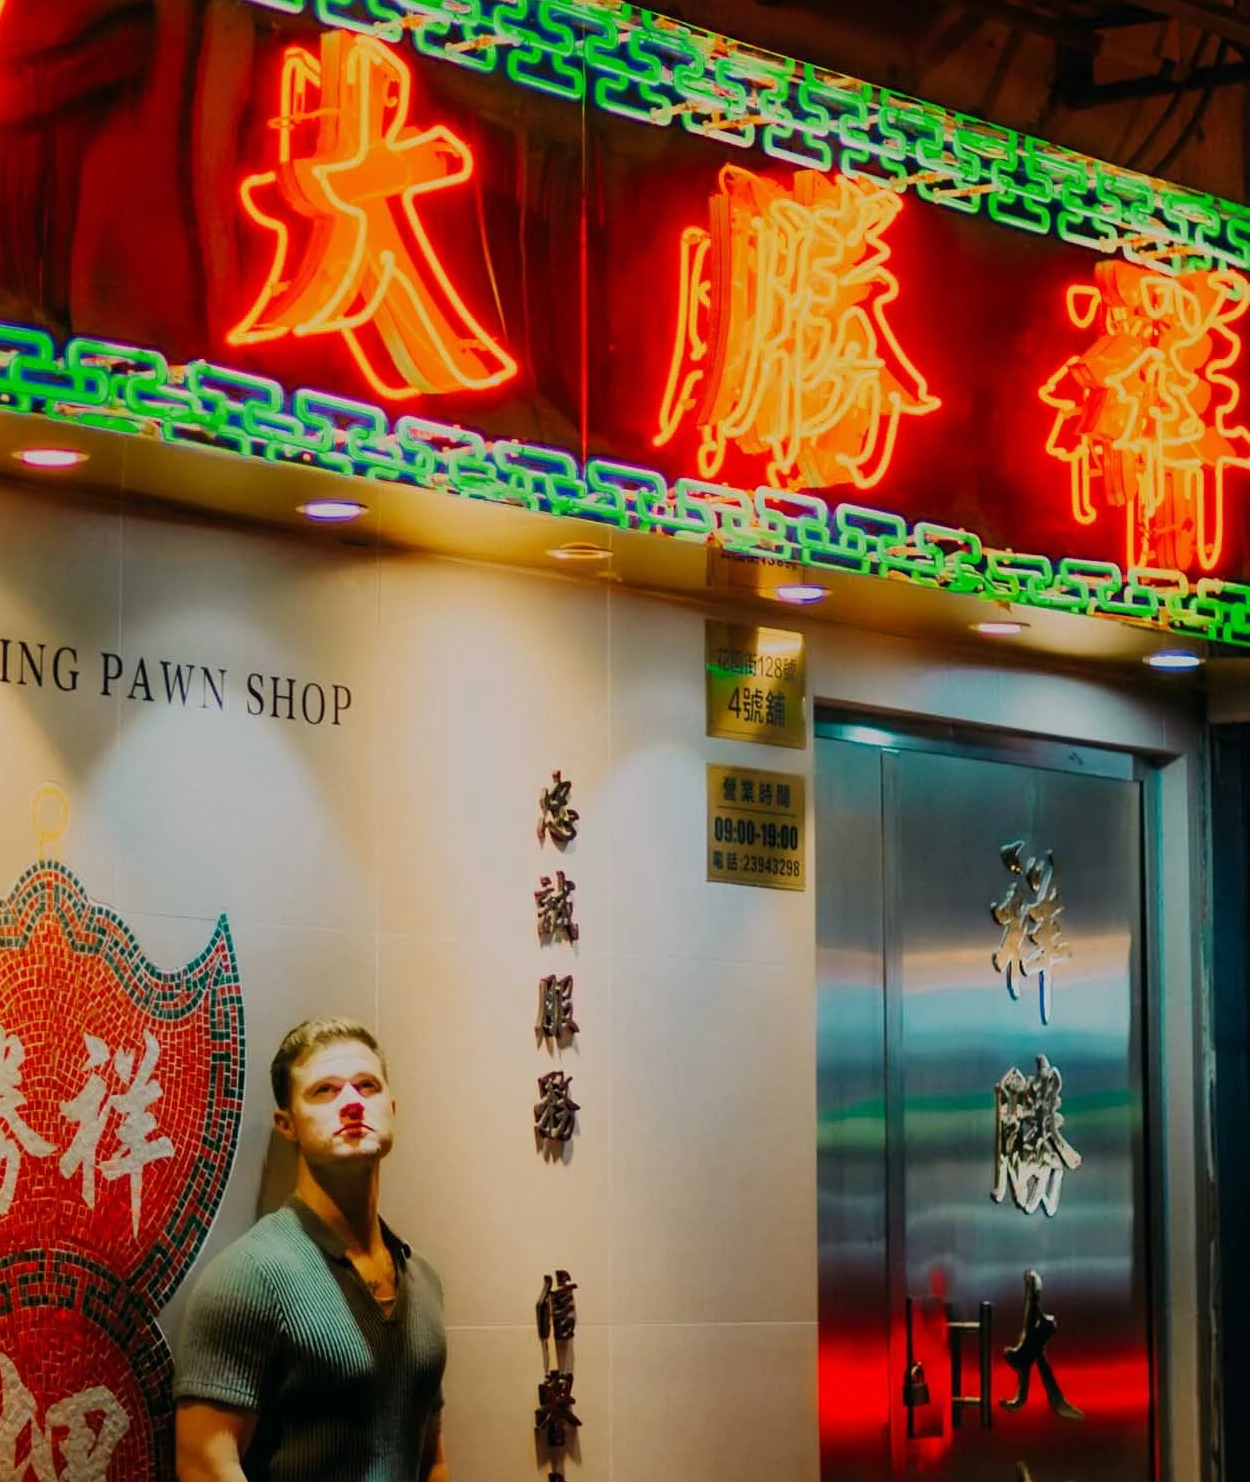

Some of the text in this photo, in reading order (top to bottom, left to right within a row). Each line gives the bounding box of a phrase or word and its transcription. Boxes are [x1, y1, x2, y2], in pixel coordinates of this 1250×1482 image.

[100, 652, 228, 712] PAWN
[246, 672, 352, 726] SHOP
[723, 777, 790, 808] 營業時間
